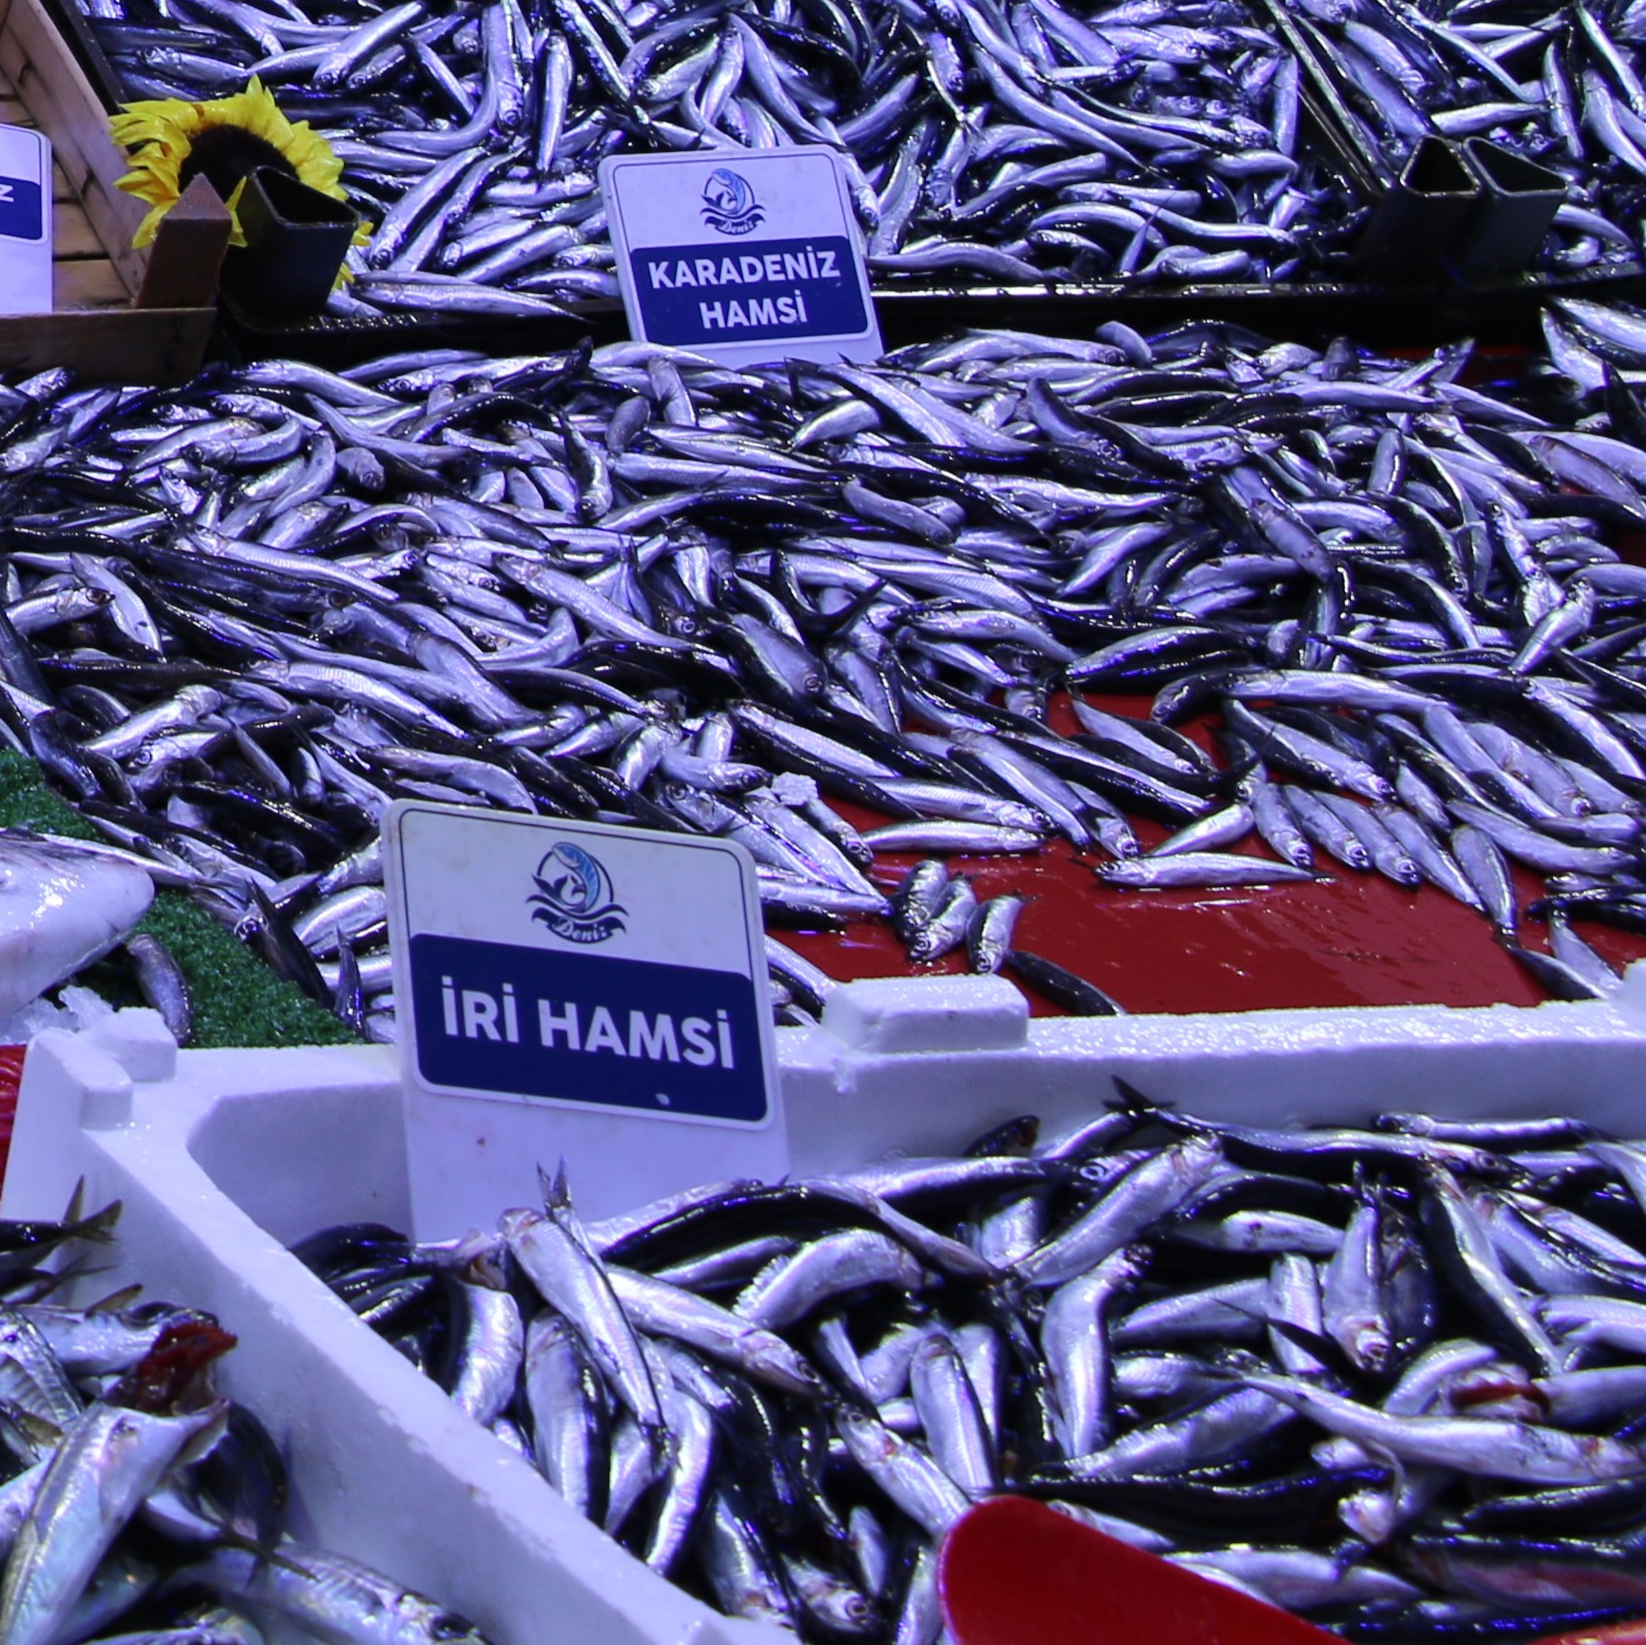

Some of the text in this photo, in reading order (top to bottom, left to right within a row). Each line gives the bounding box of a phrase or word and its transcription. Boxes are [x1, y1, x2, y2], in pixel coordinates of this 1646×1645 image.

[648, 245, 841, 289] KARADENİZ
[699, 290, 808, 329] HAMSİ
[555, 916, 609, 942] Deniz
[441, 975, 735, 1070] İRİ HAMSİ
